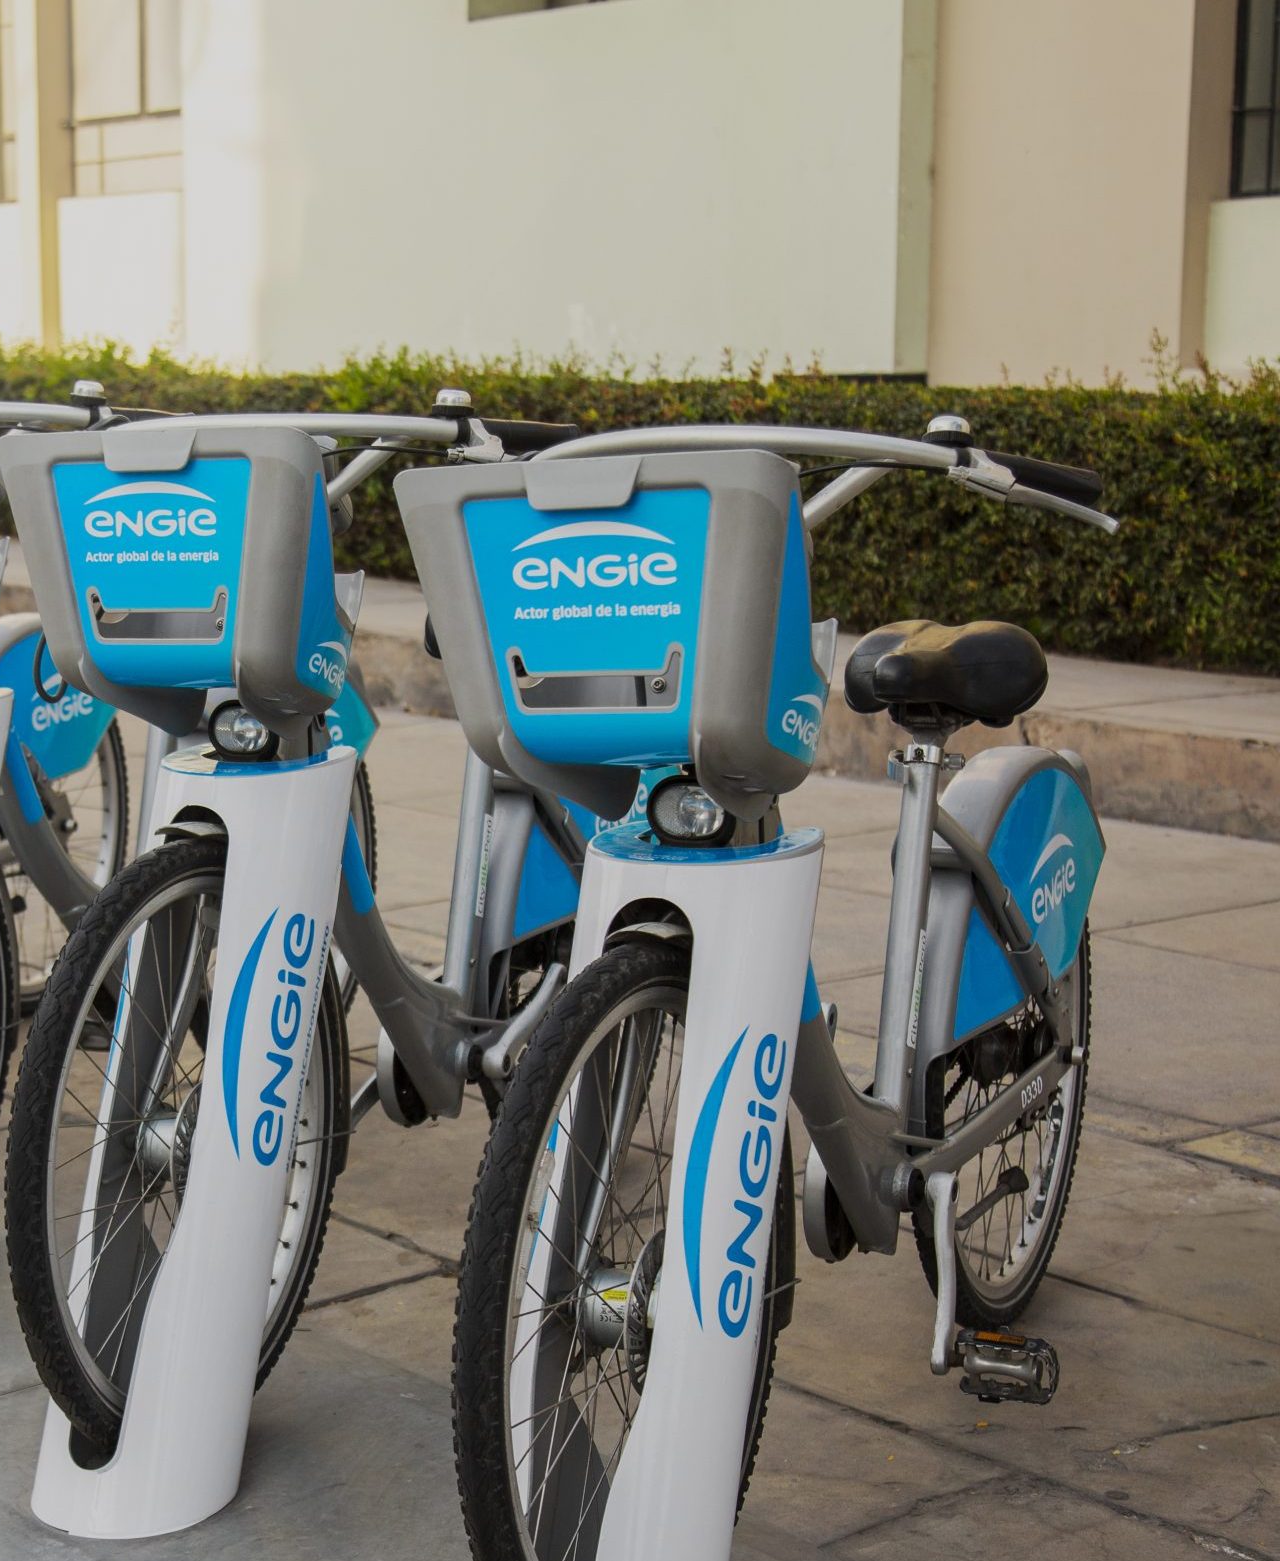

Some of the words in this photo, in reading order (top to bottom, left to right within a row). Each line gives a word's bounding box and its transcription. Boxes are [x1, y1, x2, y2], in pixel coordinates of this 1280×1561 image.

[85, 551, 114, 563] Actor
[116, 550, 149, 564] global
[151, 550, 165, 562] de
[167, 550, 176, 562] la
[179, 549, 219, 563] energía
[513, 606, 549, 620] Actor
[552, 604, 592, 621] global
[595, 603, 612, 618] de
[615, 603, 627, 617] la
[630, 601, 682, 618] energía
